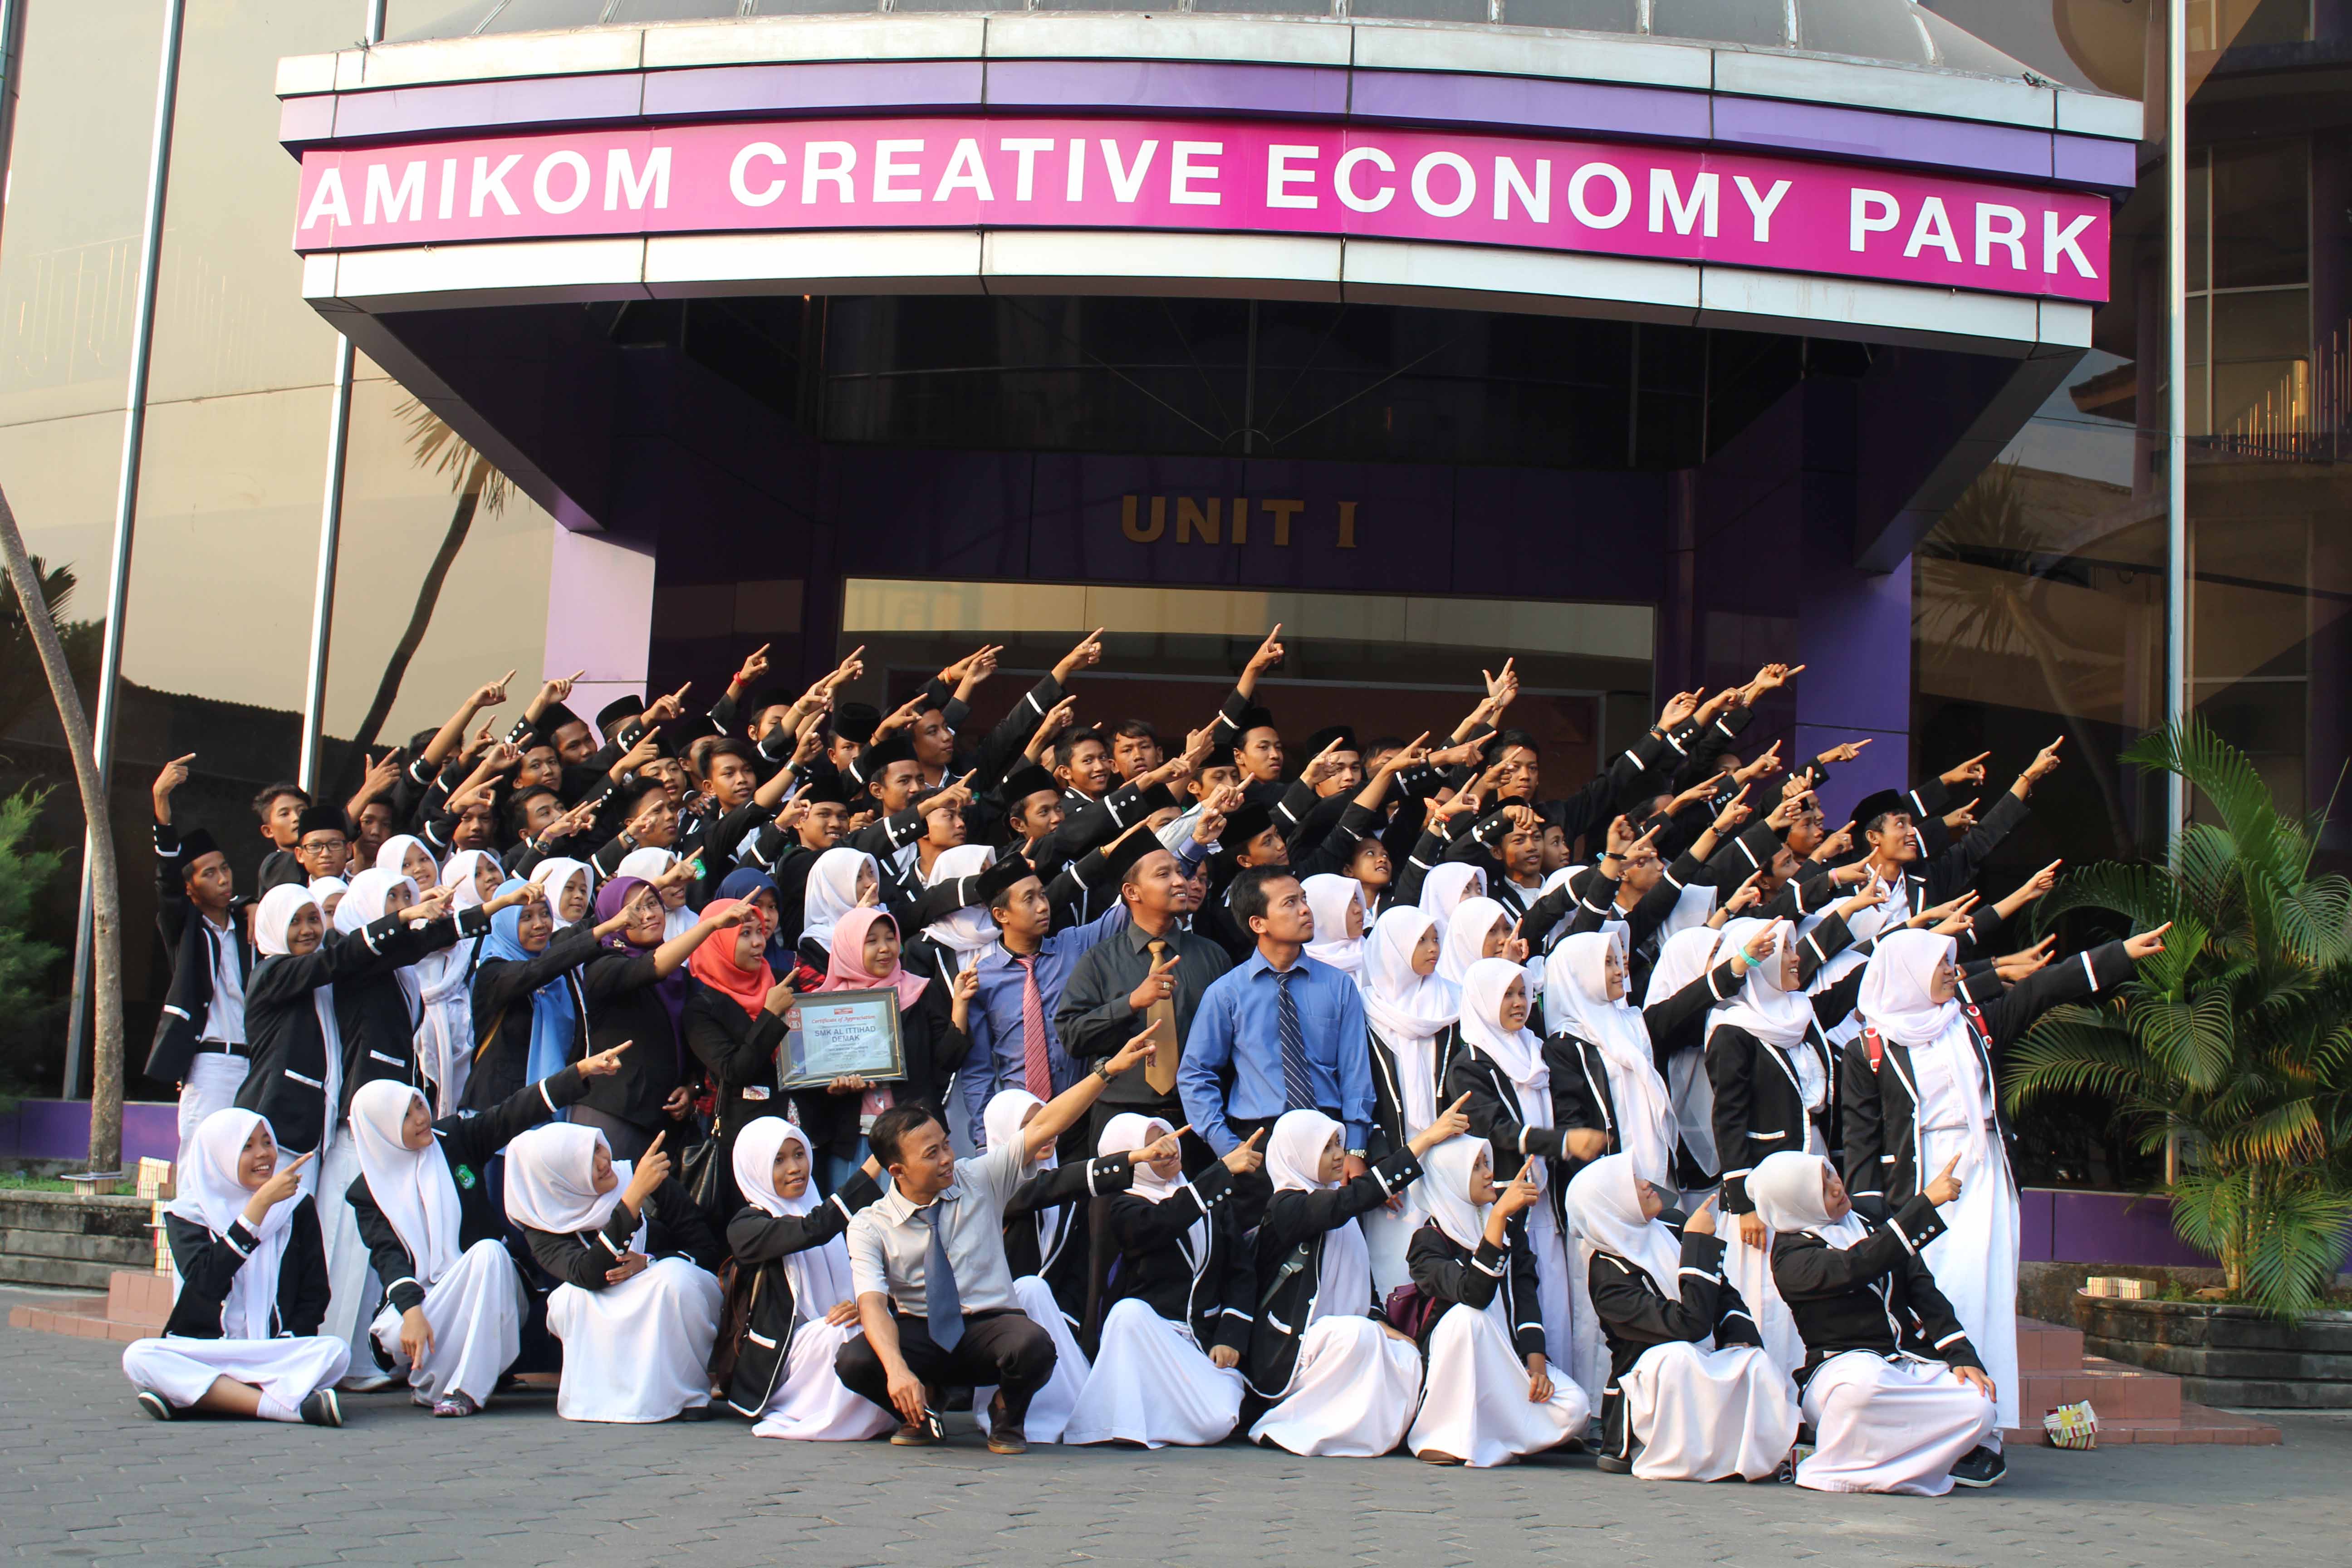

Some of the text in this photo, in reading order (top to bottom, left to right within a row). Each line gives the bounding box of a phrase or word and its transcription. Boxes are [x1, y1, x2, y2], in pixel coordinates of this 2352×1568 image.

[300, 138, 2098, 278] AMIKOM CREATIVE ECONOMY PARK
[1122, 495, 1358, 548] UNIT I
[832, 1034, 860, 1043] DEMAK
[845, 1026, 876, 1034] ITTIHAD
